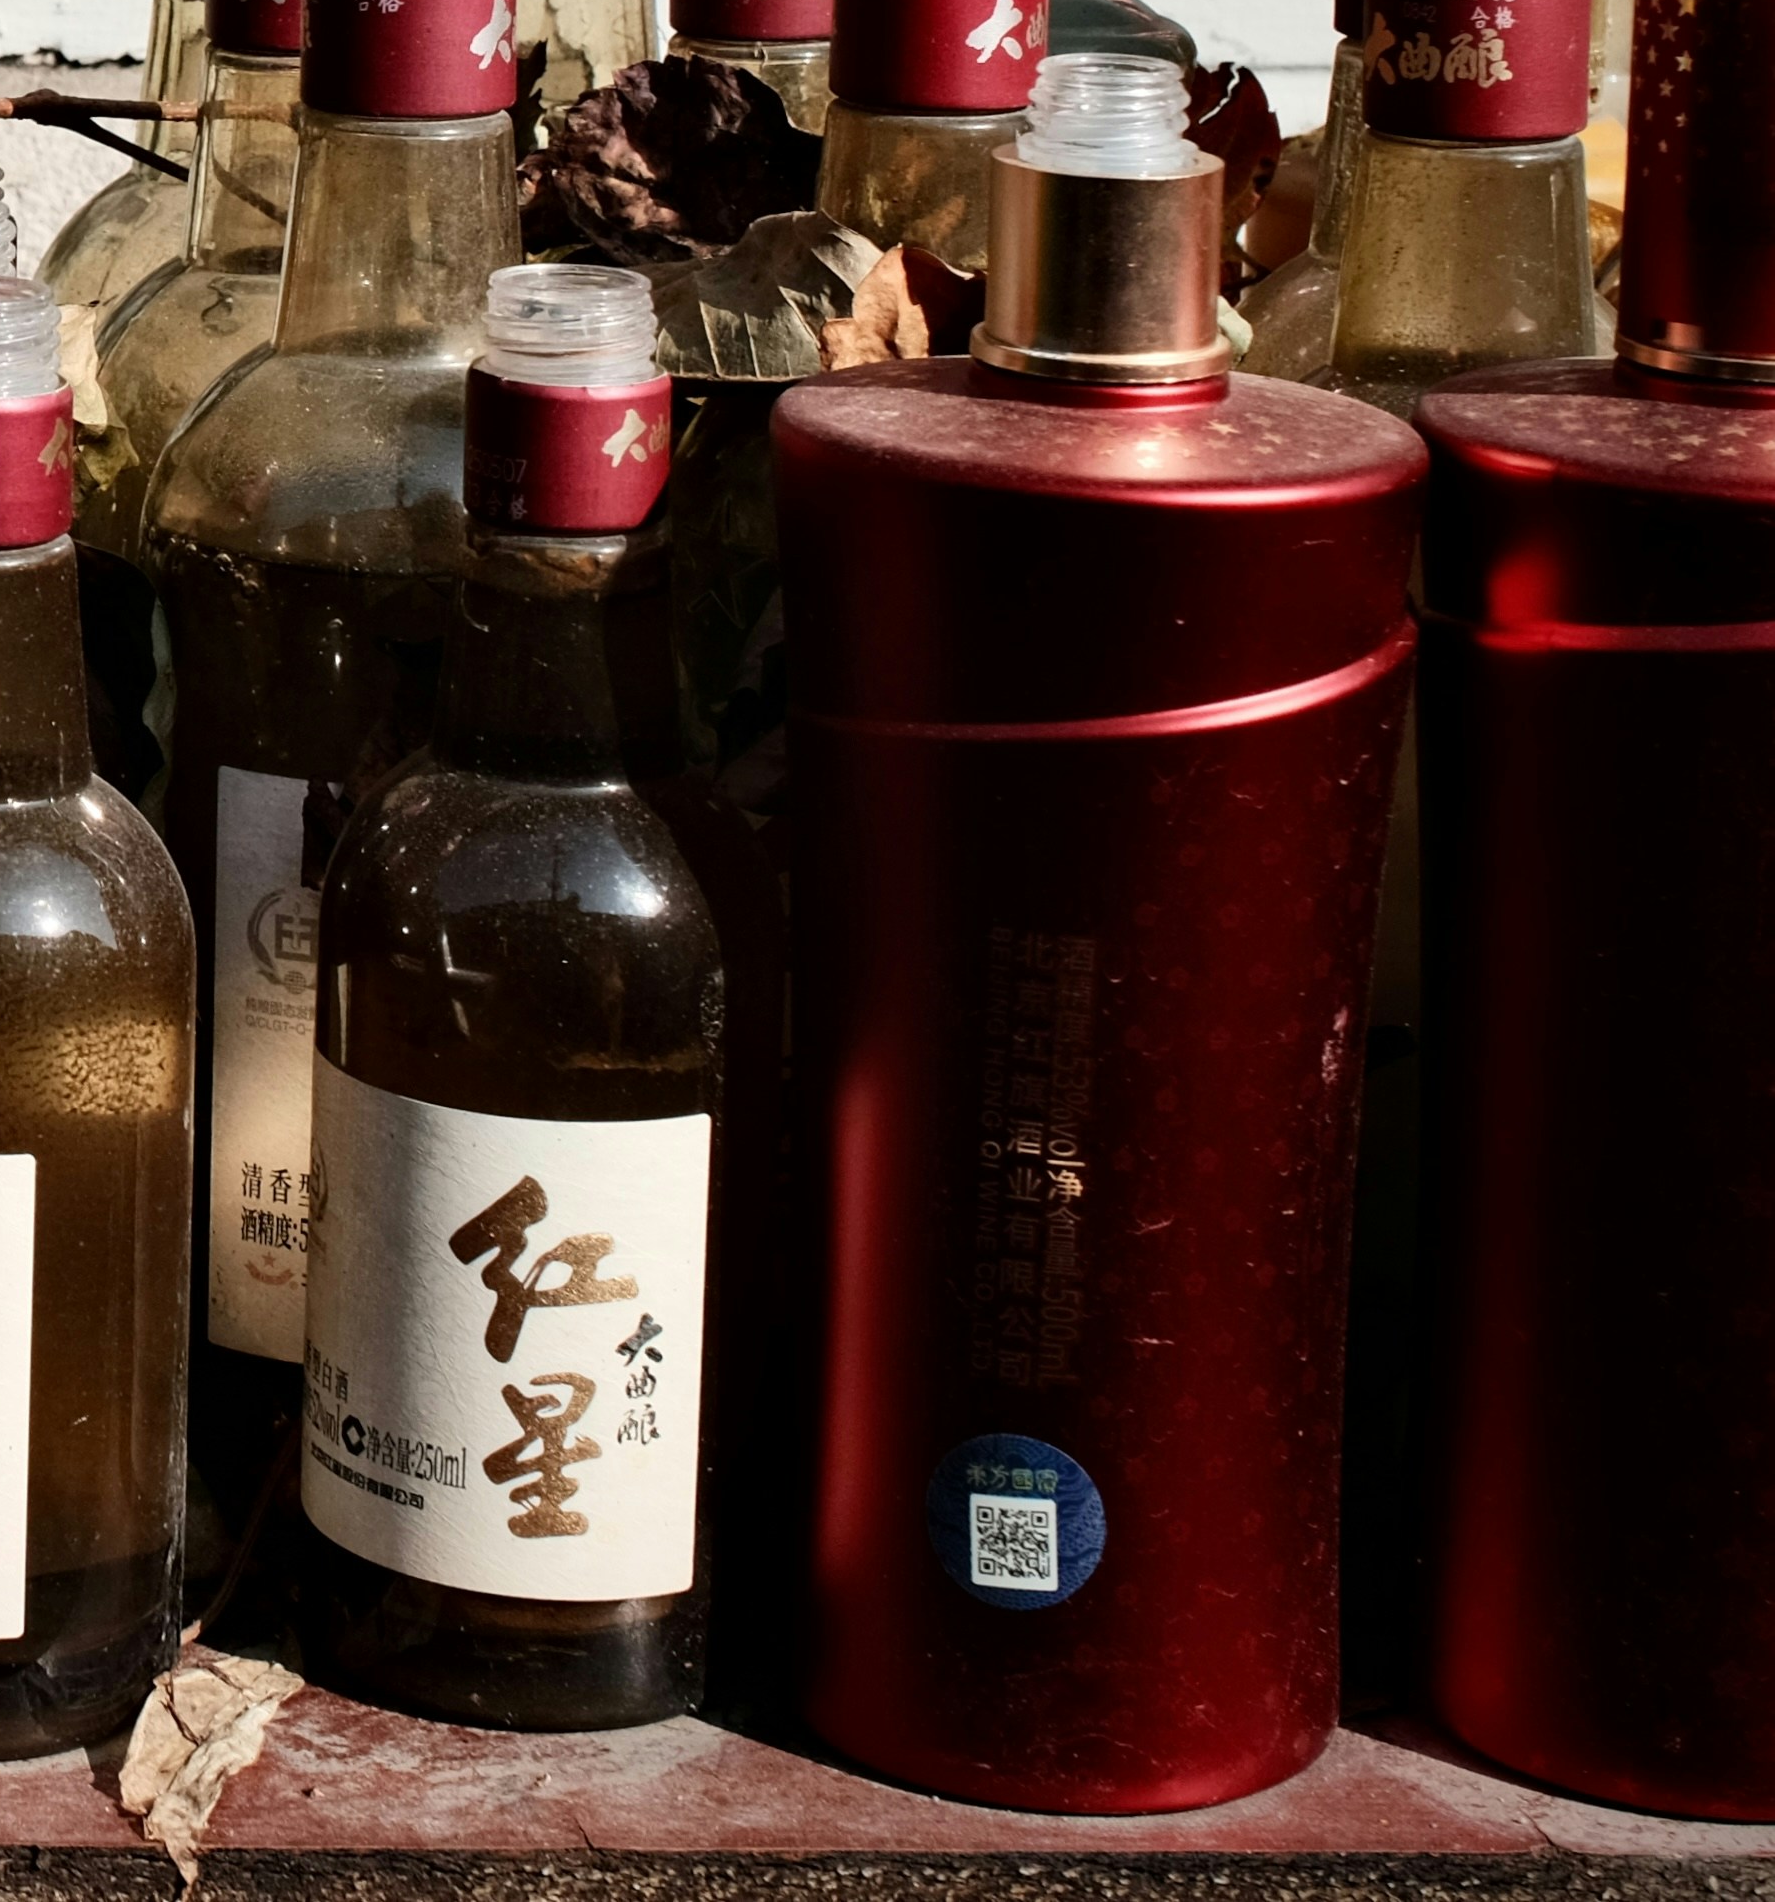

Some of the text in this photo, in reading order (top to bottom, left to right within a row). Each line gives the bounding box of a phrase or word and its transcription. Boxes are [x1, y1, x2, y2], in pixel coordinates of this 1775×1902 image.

[1364, 11, 1513, 89] 大曲酿
[1469, 5, 1516, 30] 合格
[1000, 932, 1054, 1387] 北京红旗酒业有限公司
[976, 1180, 1000, 1251] WINE
[450, 1175, 639, 1539] 红星
[616, 1312, 663, 1445] 大曲酿
[367, 1424, 467, 1490] 净含量:250ml
